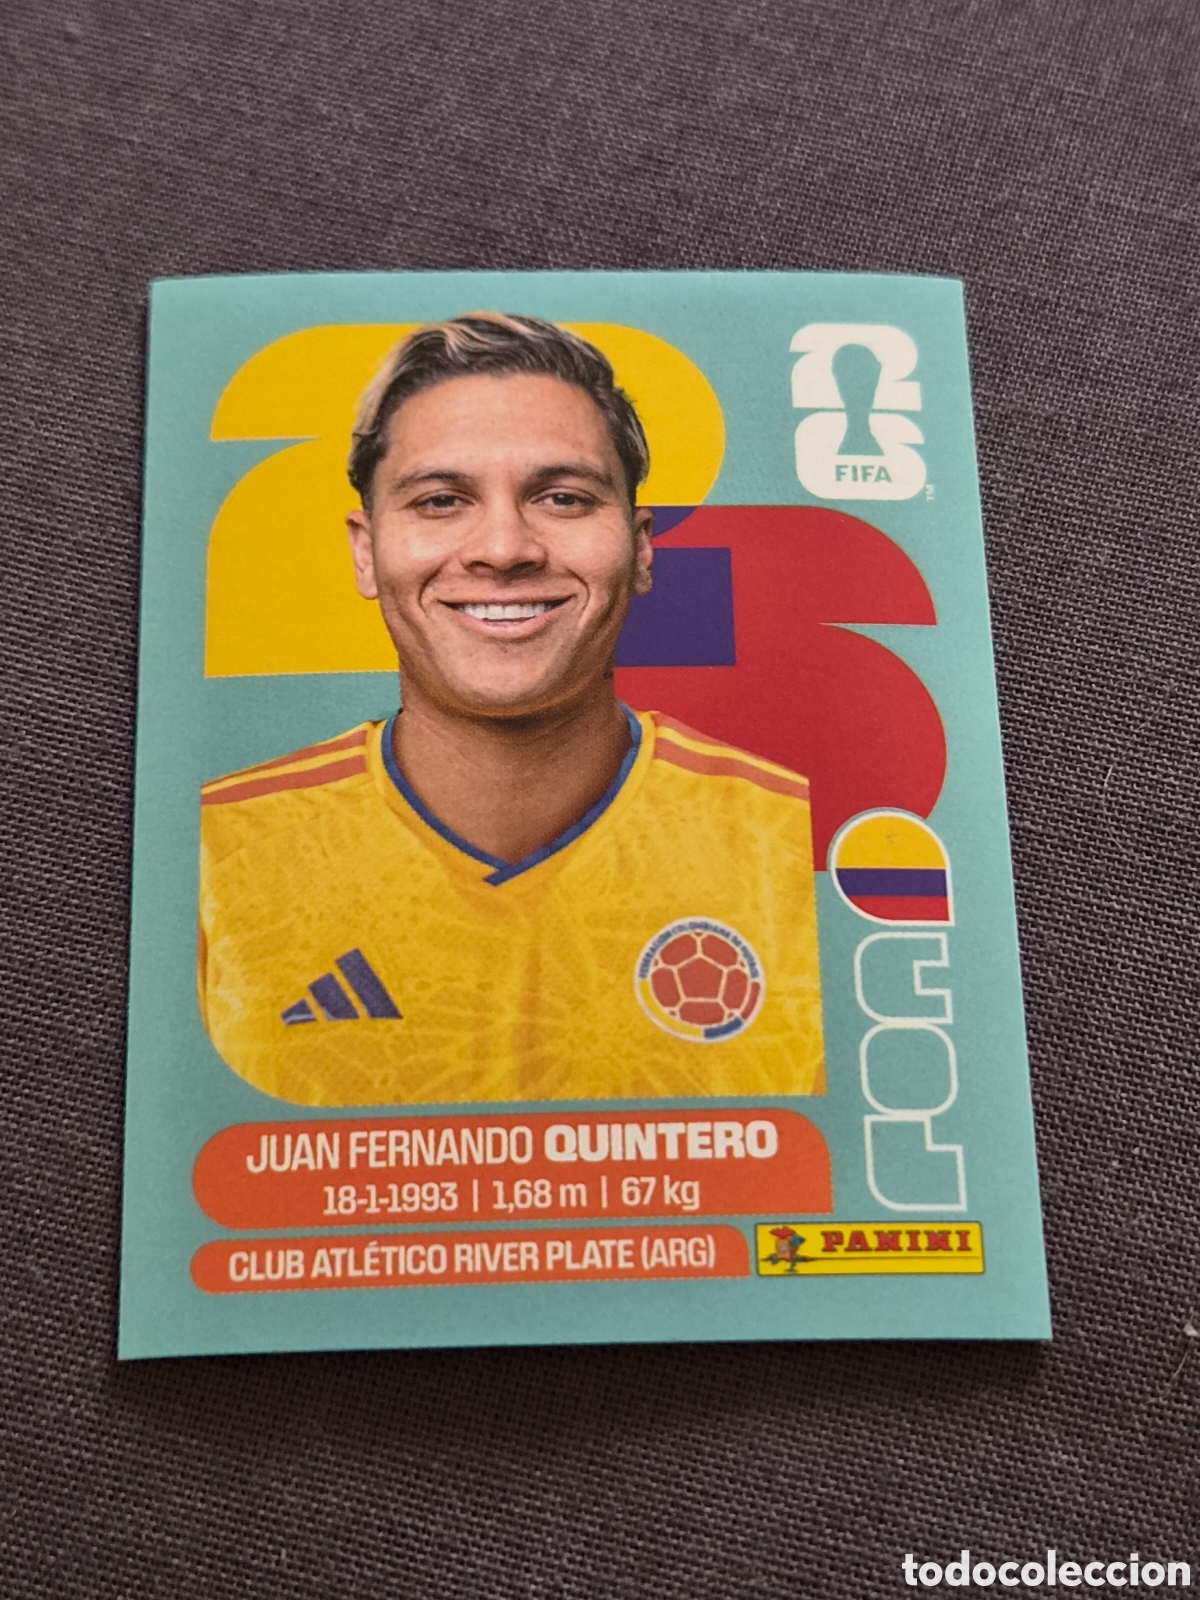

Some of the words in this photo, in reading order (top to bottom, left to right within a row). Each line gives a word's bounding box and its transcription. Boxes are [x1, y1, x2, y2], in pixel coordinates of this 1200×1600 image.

[835, 465, 892, 482] FIFA
[246, 1133, 339, 1173] JUAN
[350, 1127, 532, 1168] FERNANDO
[545, 1120, 778, 1162] QUINTERO
[324, 1182, 458, 1214] 18-1-1993
[493, 1179, 551, 1212] 1,68
[560, 1184, 587, 1207] m
[622, 1177, 656, 1206] 67
[664, 1175, 699, 1210] kg
[230, 1250, 304, 1281] CLUB
[312, 1242, 447, 1277] ATLÉTICO
[455, 1242, 539, 1272] RIVER
[547, 1240, 634, 1270] PLATE
[641, 1235, 715, 1269] (ARG)
[821, 1230, 972, 1252] PANINI
